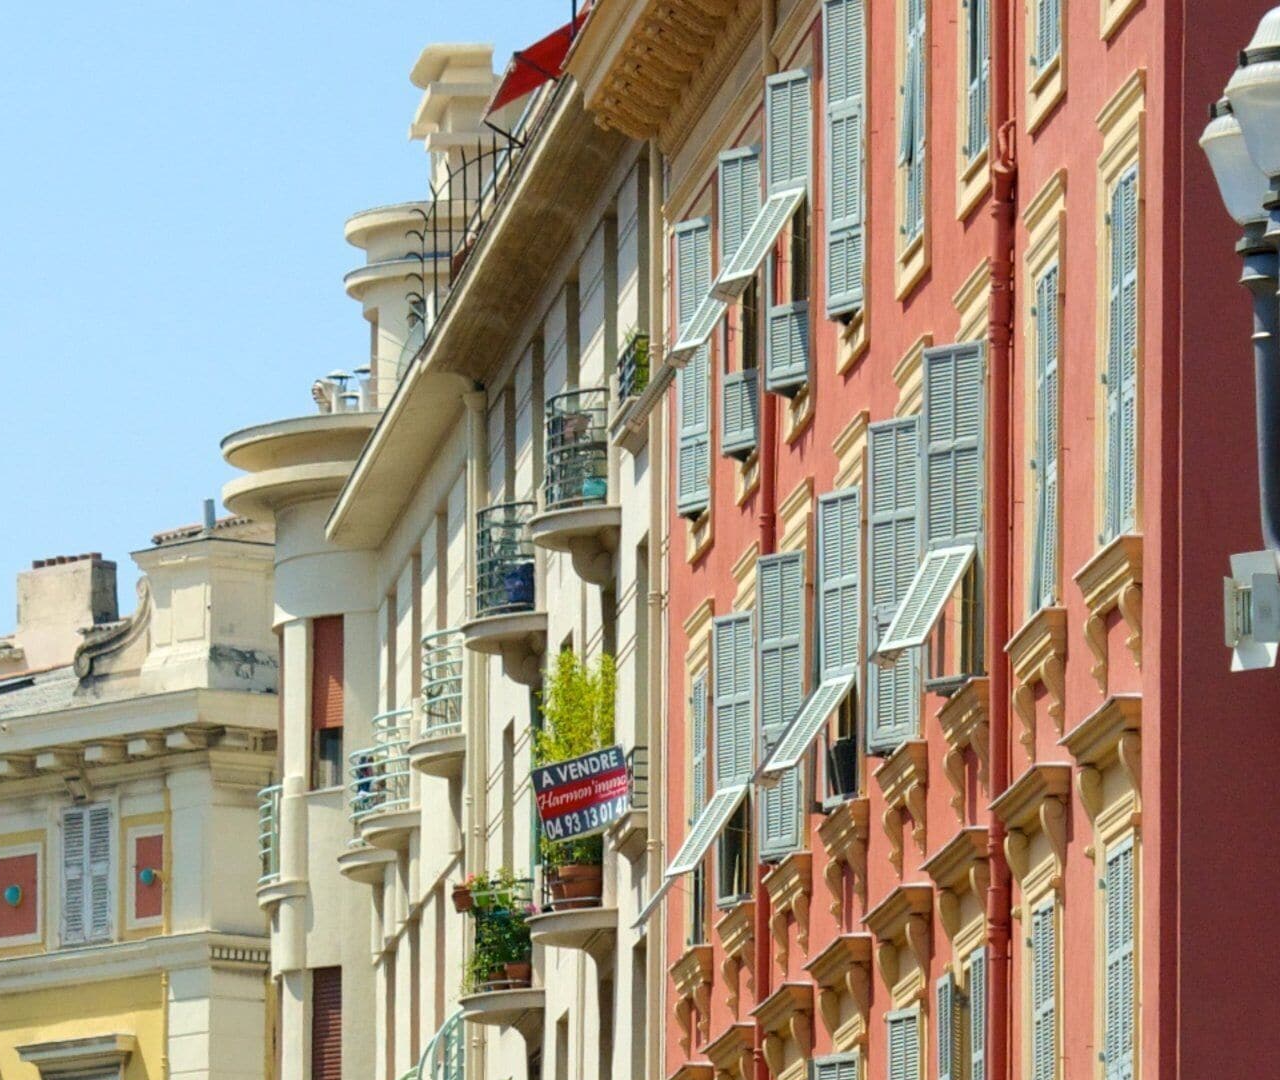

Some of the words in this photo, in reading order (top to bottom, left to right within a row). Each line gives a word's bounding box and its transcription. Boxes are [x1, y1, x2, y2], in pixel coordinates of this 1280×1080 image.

[542, 770, 555, 788] A
[557, 750, 618, 783] VENDRE
[546, 817, 564, 840] 04
[564, 812, 581, 834] 93
[583, 807, 599, 829] 13
[600, 801, 613, 823] 01
